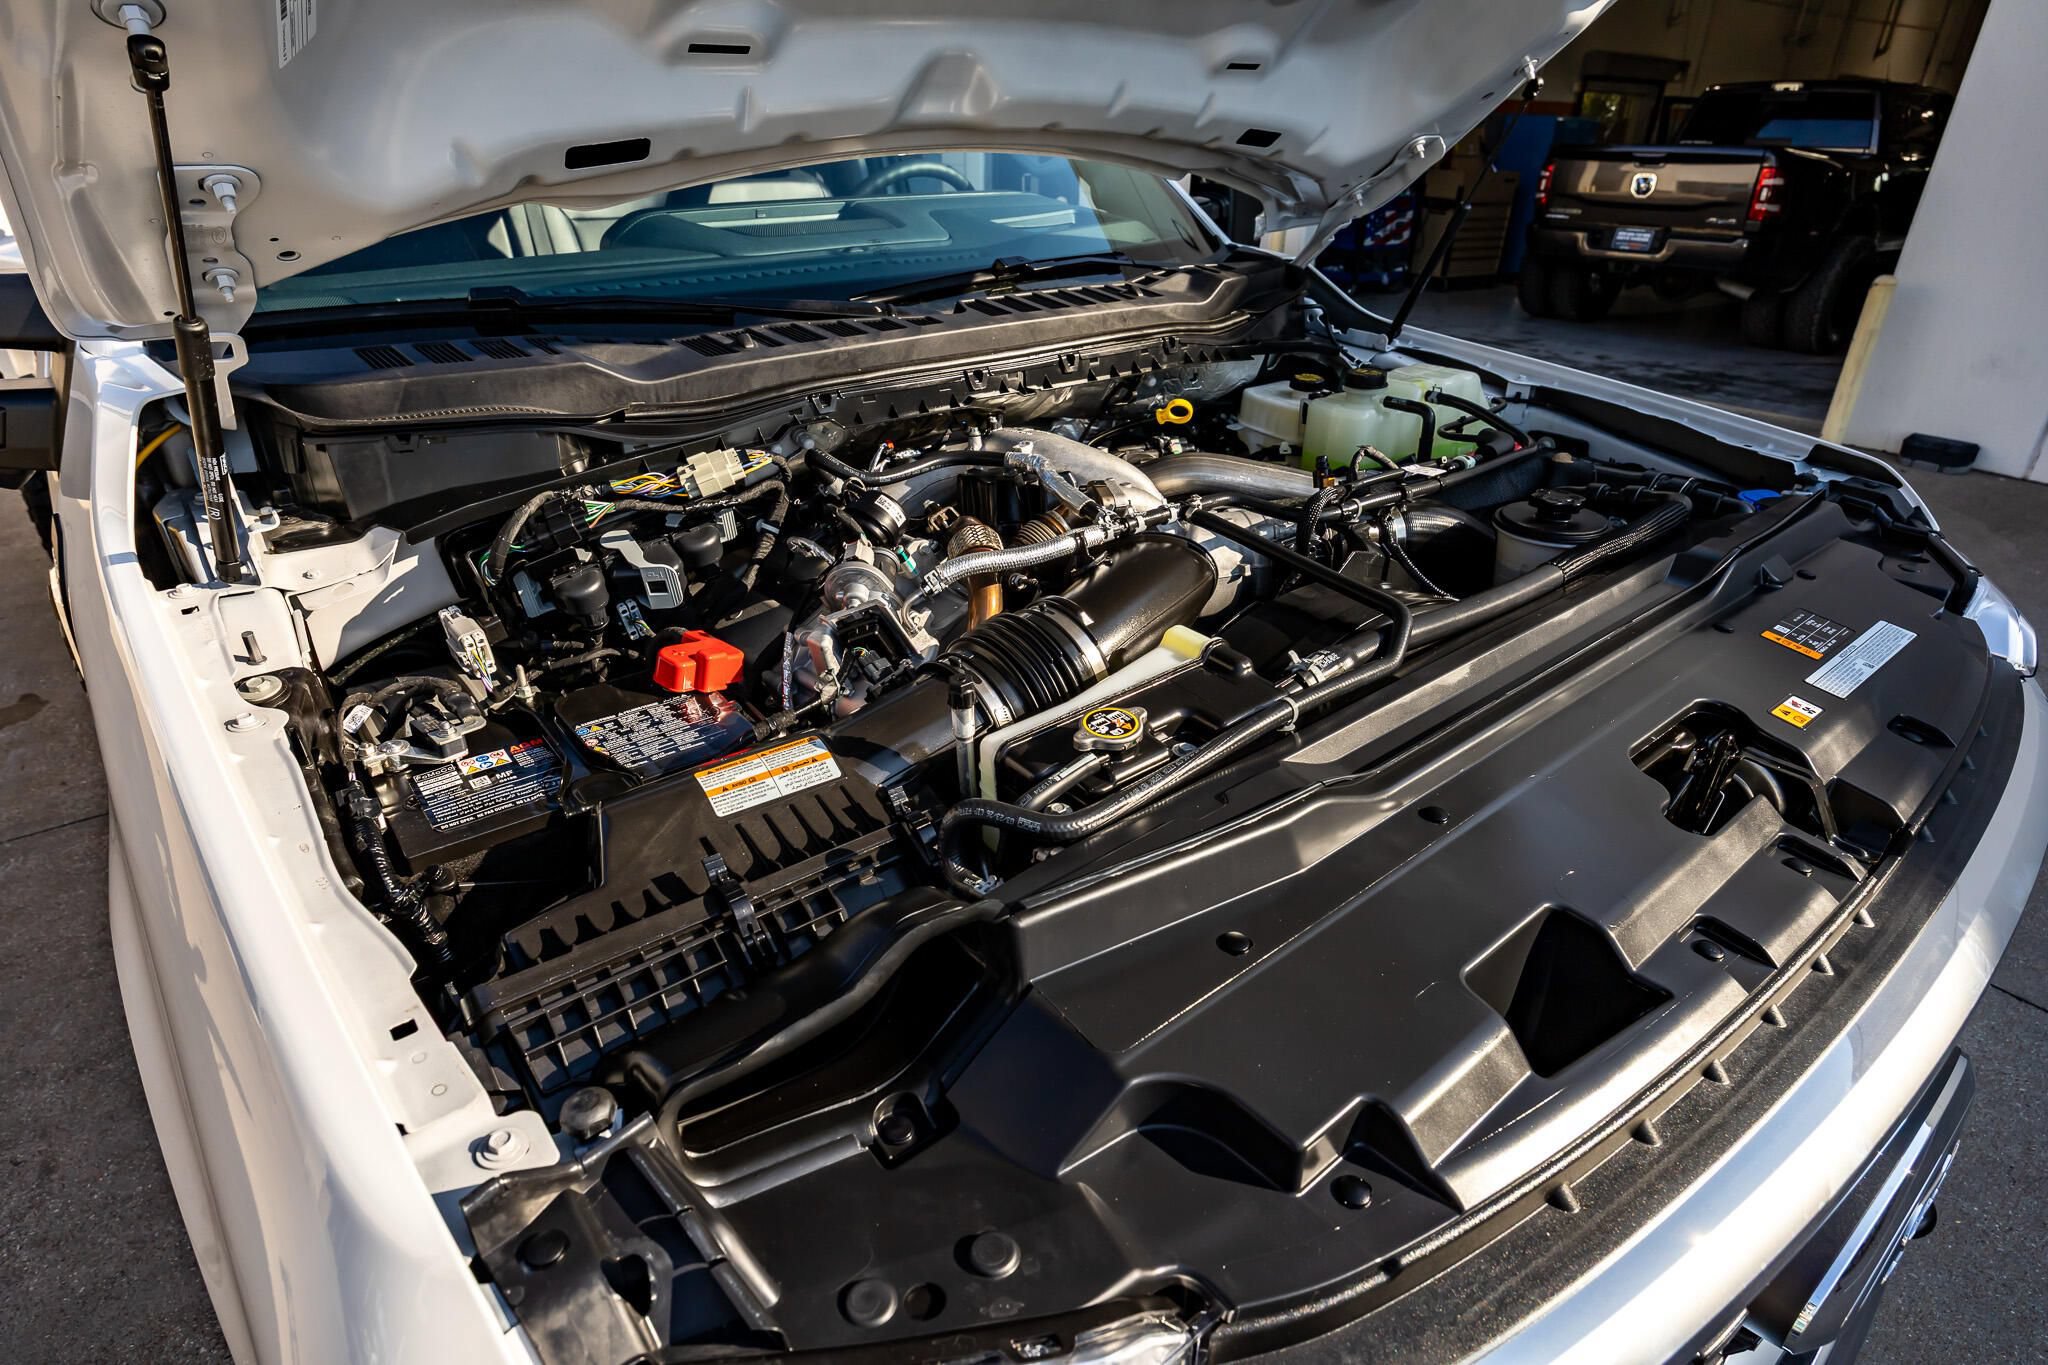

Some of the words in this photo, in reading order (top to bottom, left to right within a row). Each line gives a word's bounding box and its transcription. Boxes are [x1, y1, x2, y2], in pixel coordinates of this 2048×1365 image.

[509, 738, 543, 752] AGM
[714, 762, 738, 772] WARNING
[416, 766, 453, 781] FoMoCo
[731, 780, 747, 788] AVISO
